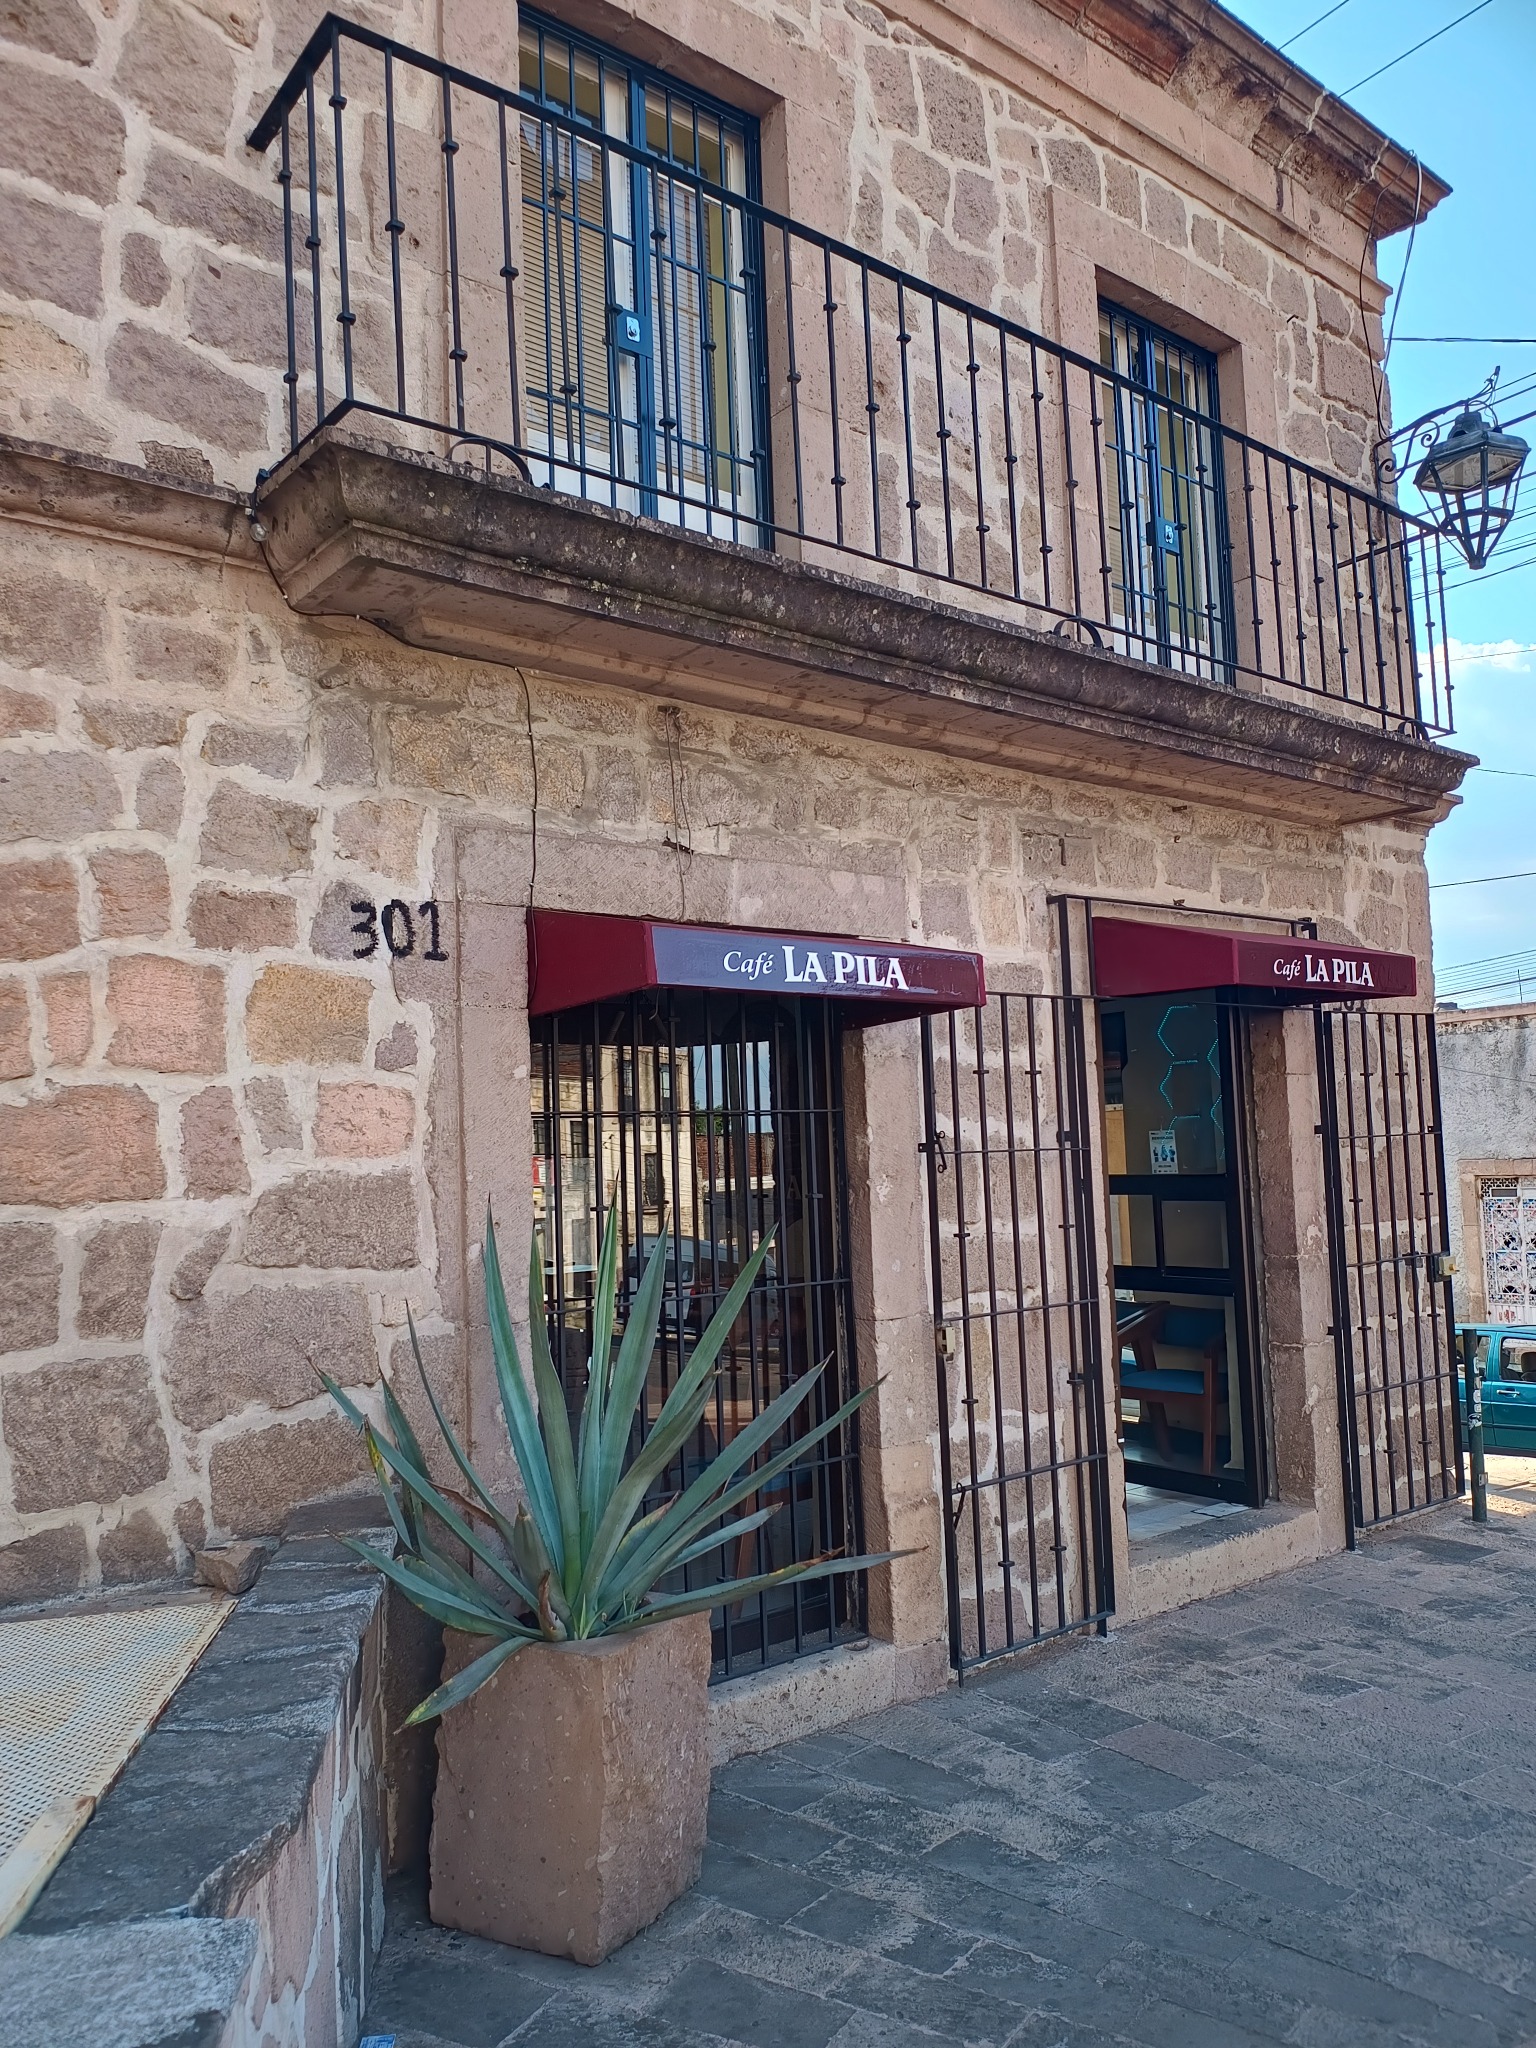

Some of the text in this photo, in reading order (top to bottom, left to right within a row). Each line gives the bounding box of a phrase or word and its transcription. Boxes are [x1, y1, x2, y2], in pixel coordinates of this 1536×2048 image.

[350, 899, 449, 962] 301
[723, 945, 910, 990] Café LA PILA
[1273, 958, 1301, 981] Café
[1304, 954, 1330, 983] LA
[1332, 958, 1375, 987] PILA
